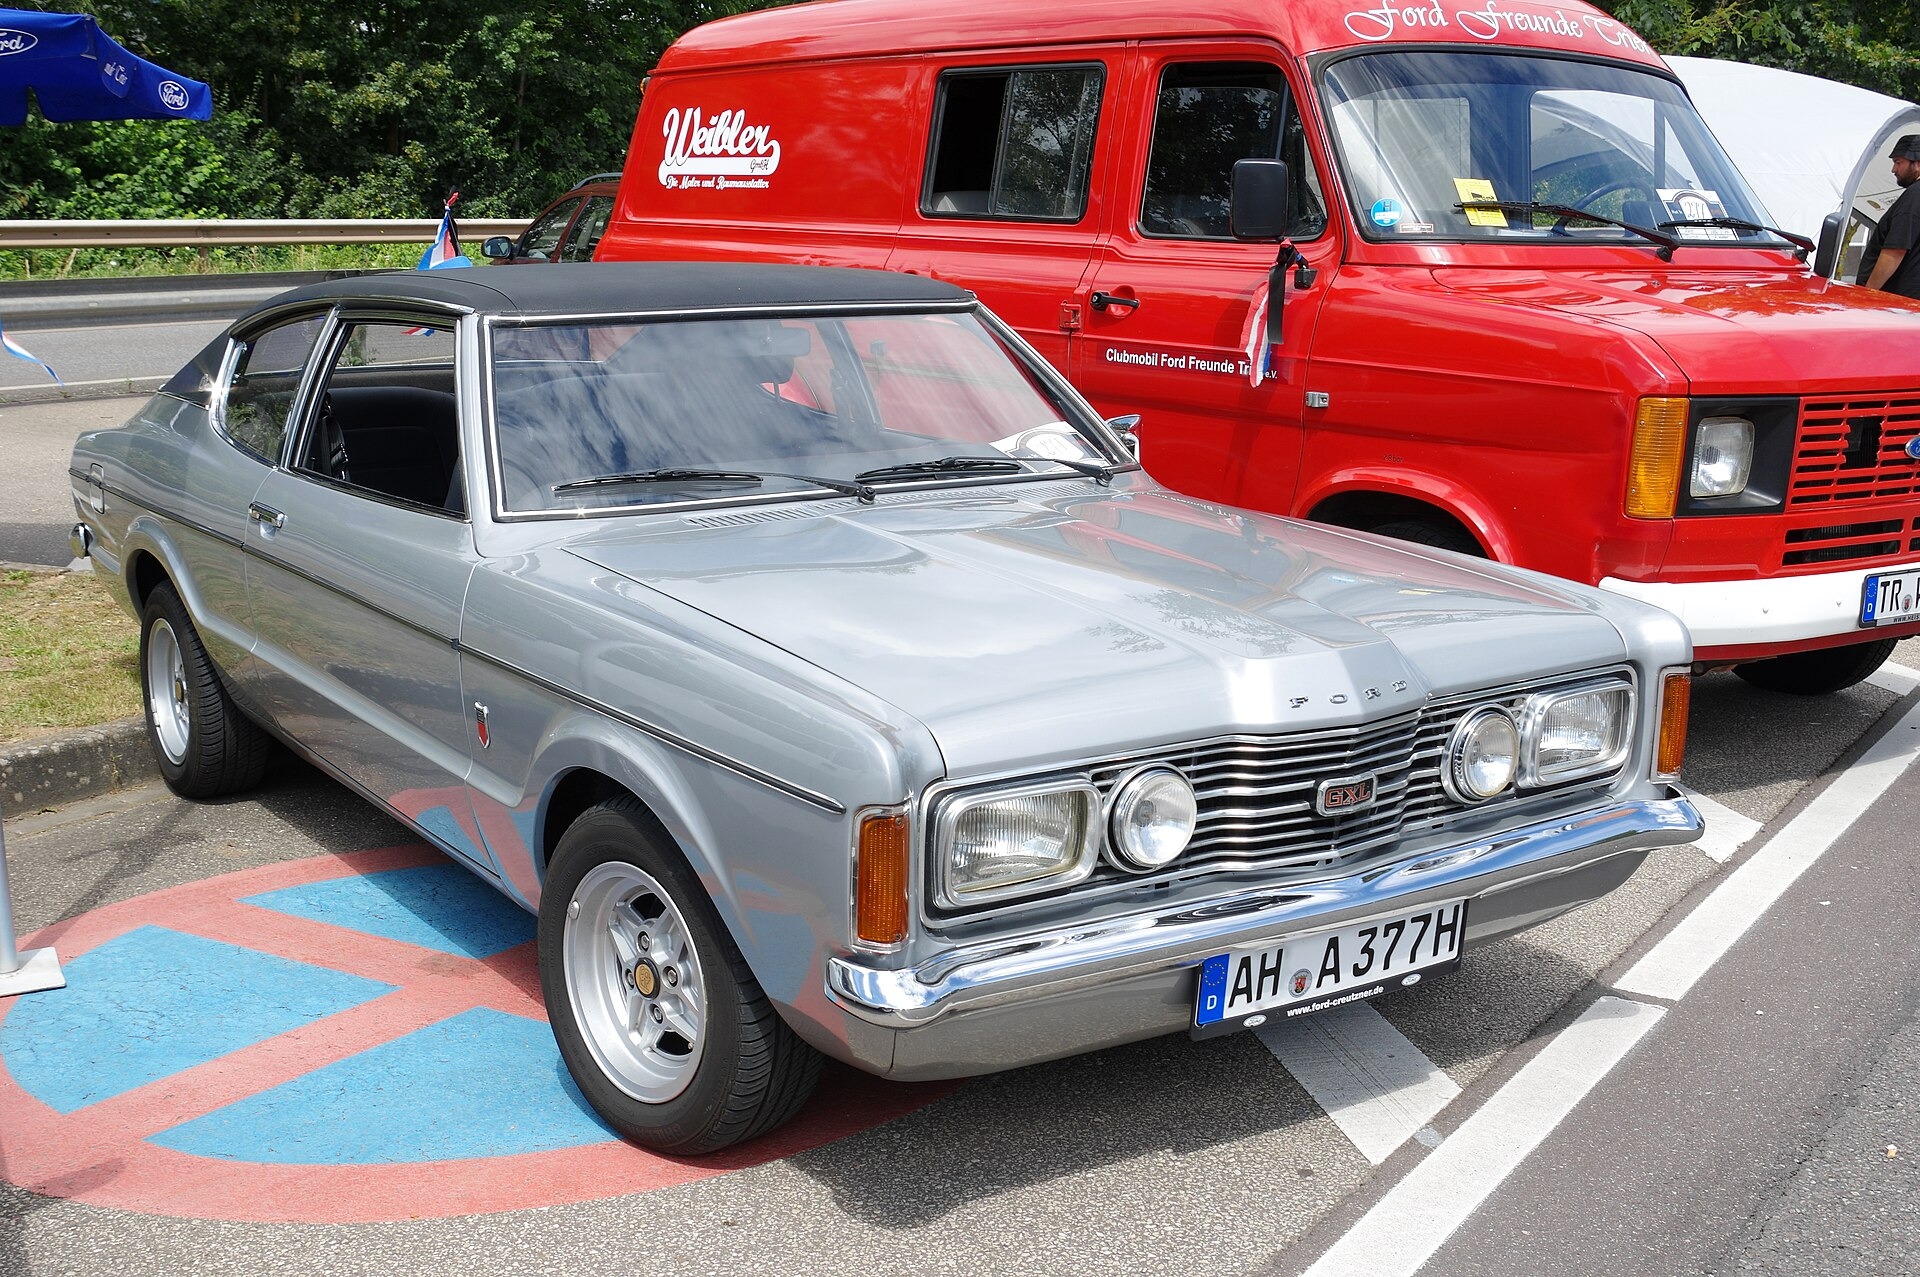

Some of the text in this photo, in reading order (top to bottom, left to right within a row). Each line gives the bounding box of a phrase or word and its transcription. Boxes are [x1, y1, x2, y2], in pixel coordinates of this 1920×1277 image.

[1344, 0, 1650, 55] Ford Freunde Trier
[163, 83, 185, 106] Ford
[662, 106, 771, 166] Weibler
[1105, 348, 1278, 379] Clubmobil Ford Freunde Tri e.V.
[1867, 603, 1873, 613] D
[1880, 579, 1902, 613] TR
[1289, 680, 1407, 708] FORD
[1325, 783, 1371, 807] GXL
[1228, 904, 1461, 1007] AH A 377H
[1206, 995, 1217, 1010] D
[1286, 984, 1384, 1017] www.ford-creutzner.de
